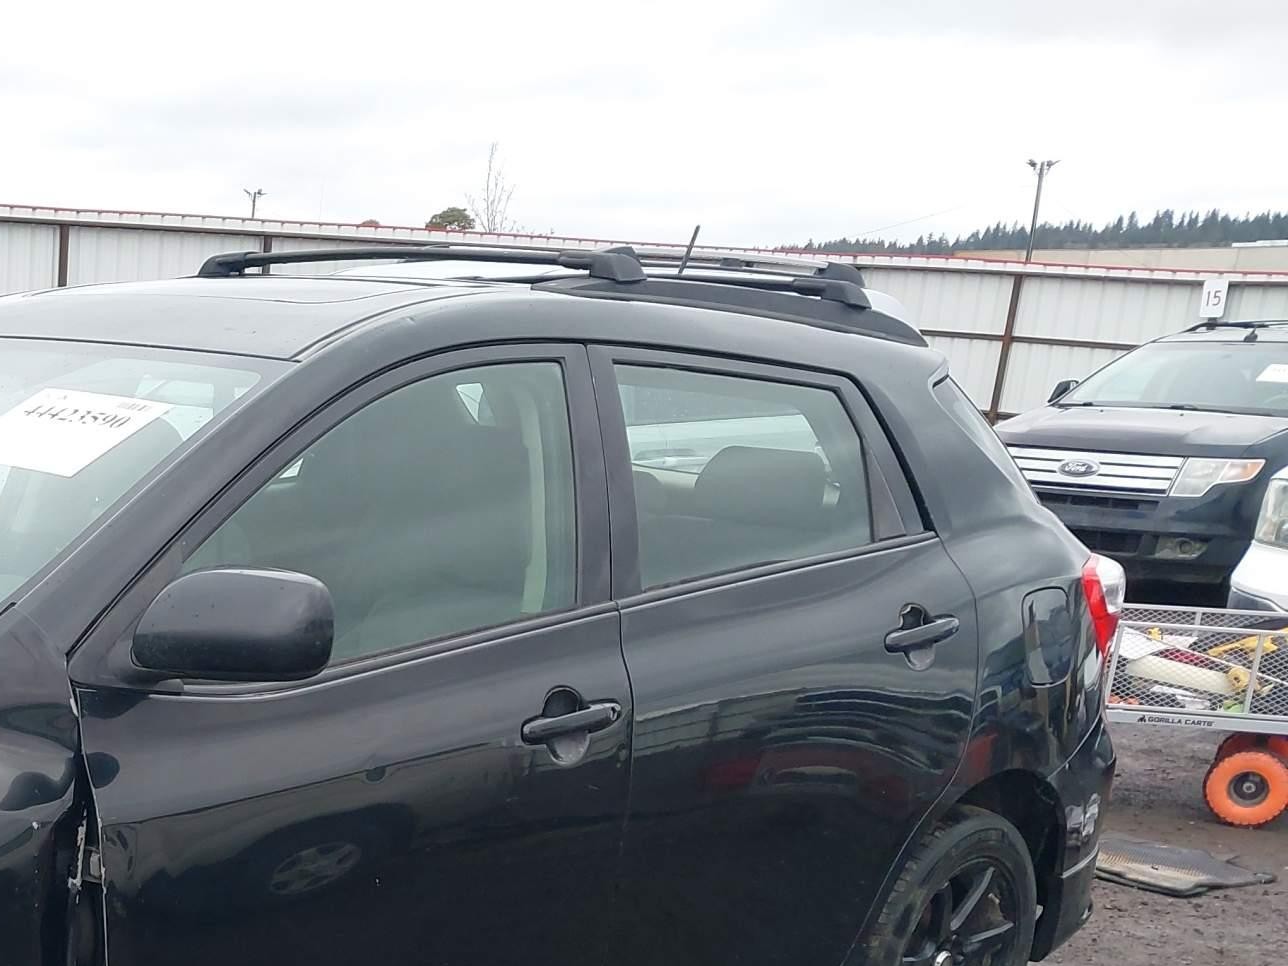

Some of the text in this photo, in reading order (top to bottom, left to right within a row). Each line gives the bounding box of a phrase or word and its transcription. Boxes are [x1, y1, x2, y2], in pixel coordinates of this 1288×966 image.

[1206, 290, 1222, 307] 15
[23, 405, 131, 428] 44423590
[1148, 716, 1182, 725] GORILLA
